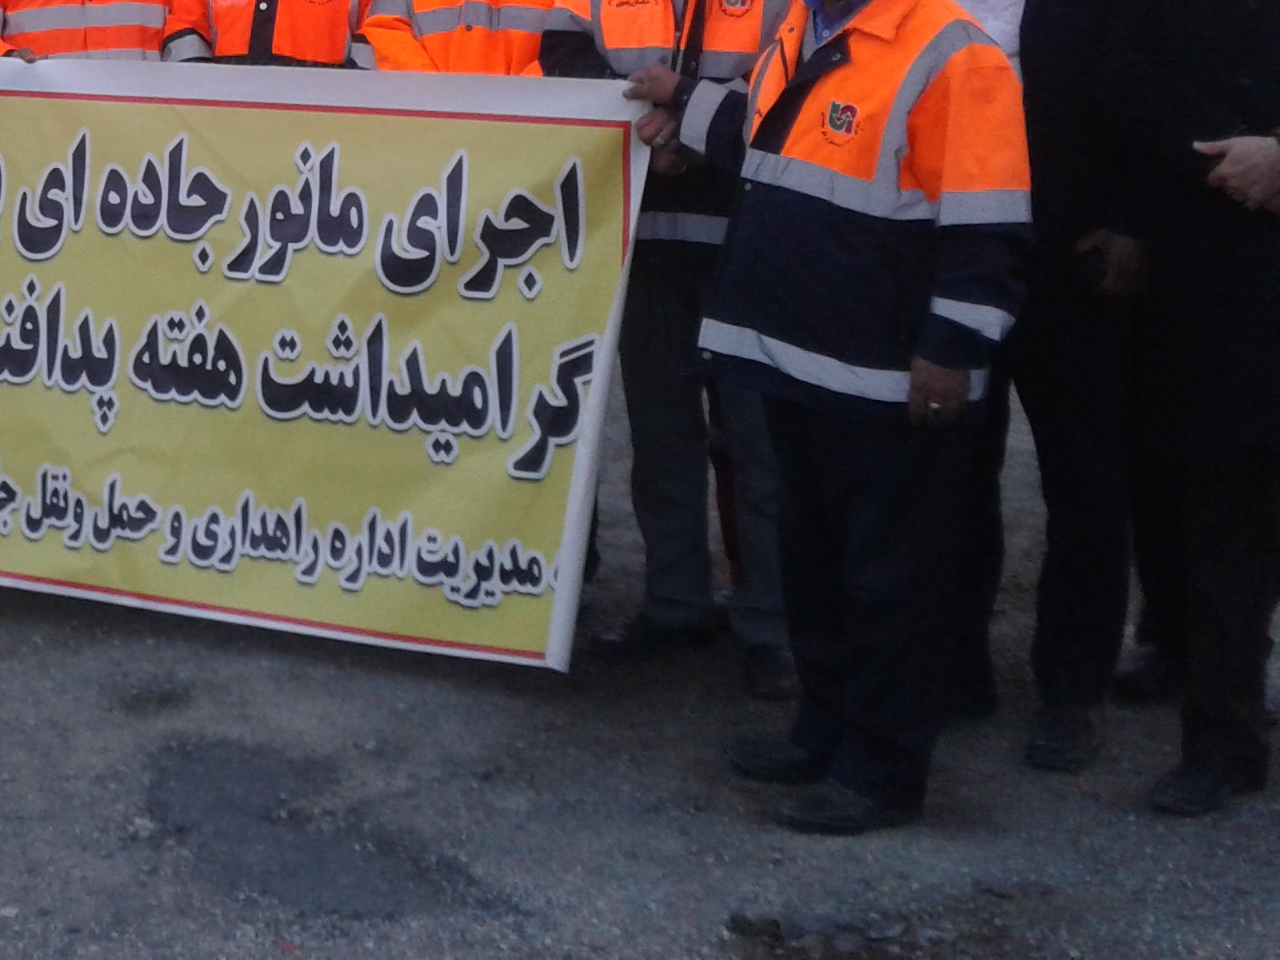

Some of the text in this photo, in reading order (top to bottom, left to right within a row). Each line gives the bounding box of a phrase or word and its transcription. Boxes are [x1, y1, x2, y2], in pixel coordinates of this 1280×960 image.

[15, 131, 88, 265] ای
[97, 137, 230, 272] جاده
[222, 145, 366, 284] مانور
[378, 155, 582, 304] اجرای
[131, 303, 245, 408] هفته
[258, 317, 597, 475] گرامیداشت
[91, 478, 159, 545] حمل
[160, 509, 184, 568] و
[189, 496, 321, 578] راهداری
[328, 512, 409, 585] اداره
[413, 534, 544, 611] مدیریت
